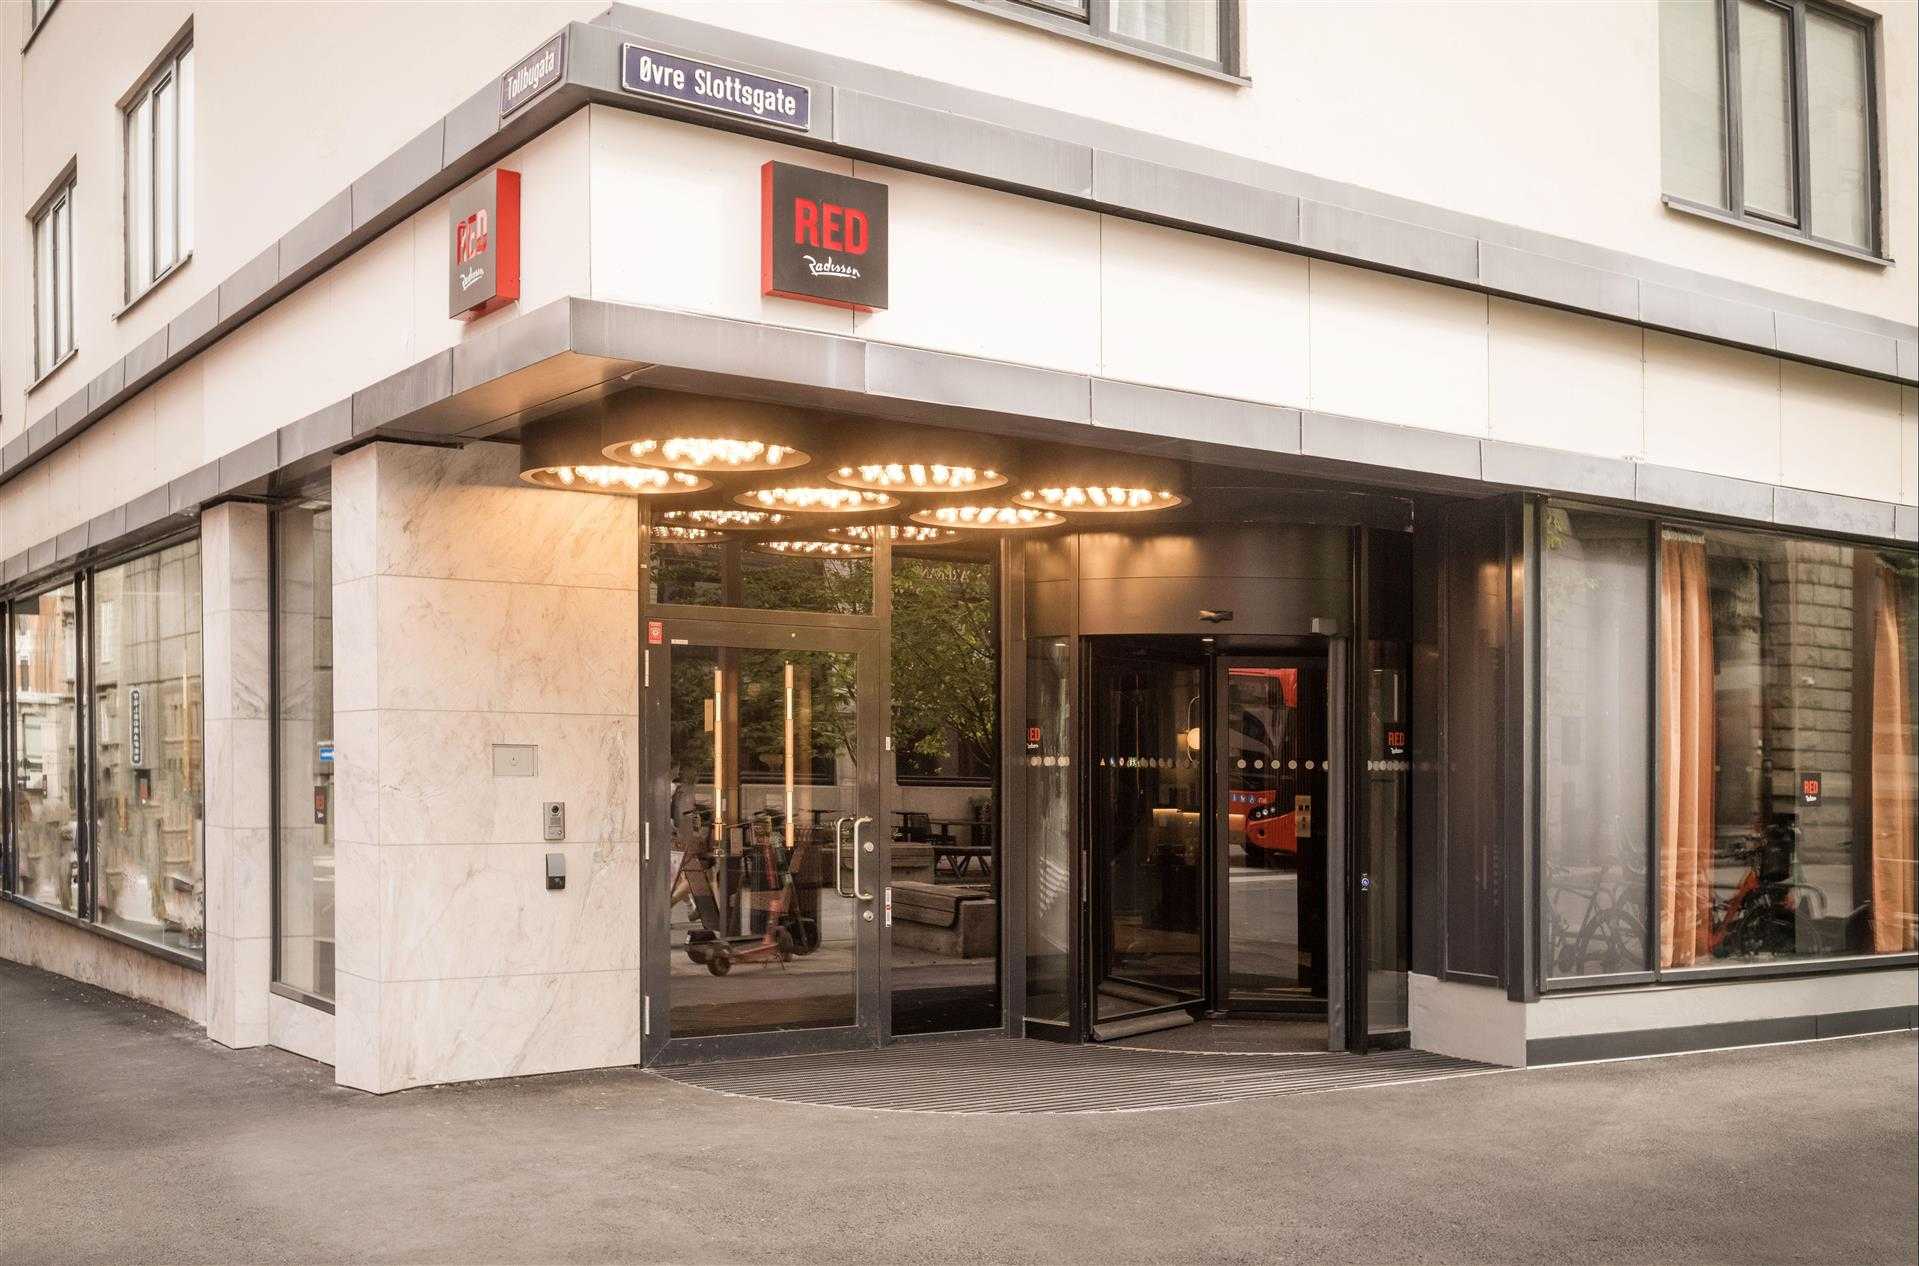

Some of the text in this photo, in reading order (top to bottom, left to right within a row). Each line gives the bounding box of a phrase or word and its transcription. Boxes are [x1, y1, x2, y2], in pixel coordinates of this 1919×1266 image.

[507, 50, 555, 100] Tollbugata
[639, 55, 796, 116] Øvre Slottsgate
[456, 208, 488, 266] RED
[794, 196, 870, 256] RED
[802, 254, 861, 279] Radisson
[1028, 727, 1041, 742] ED
[1388, 731, 1405, 746] RED
[1804, 780, 1819, 794] RED
